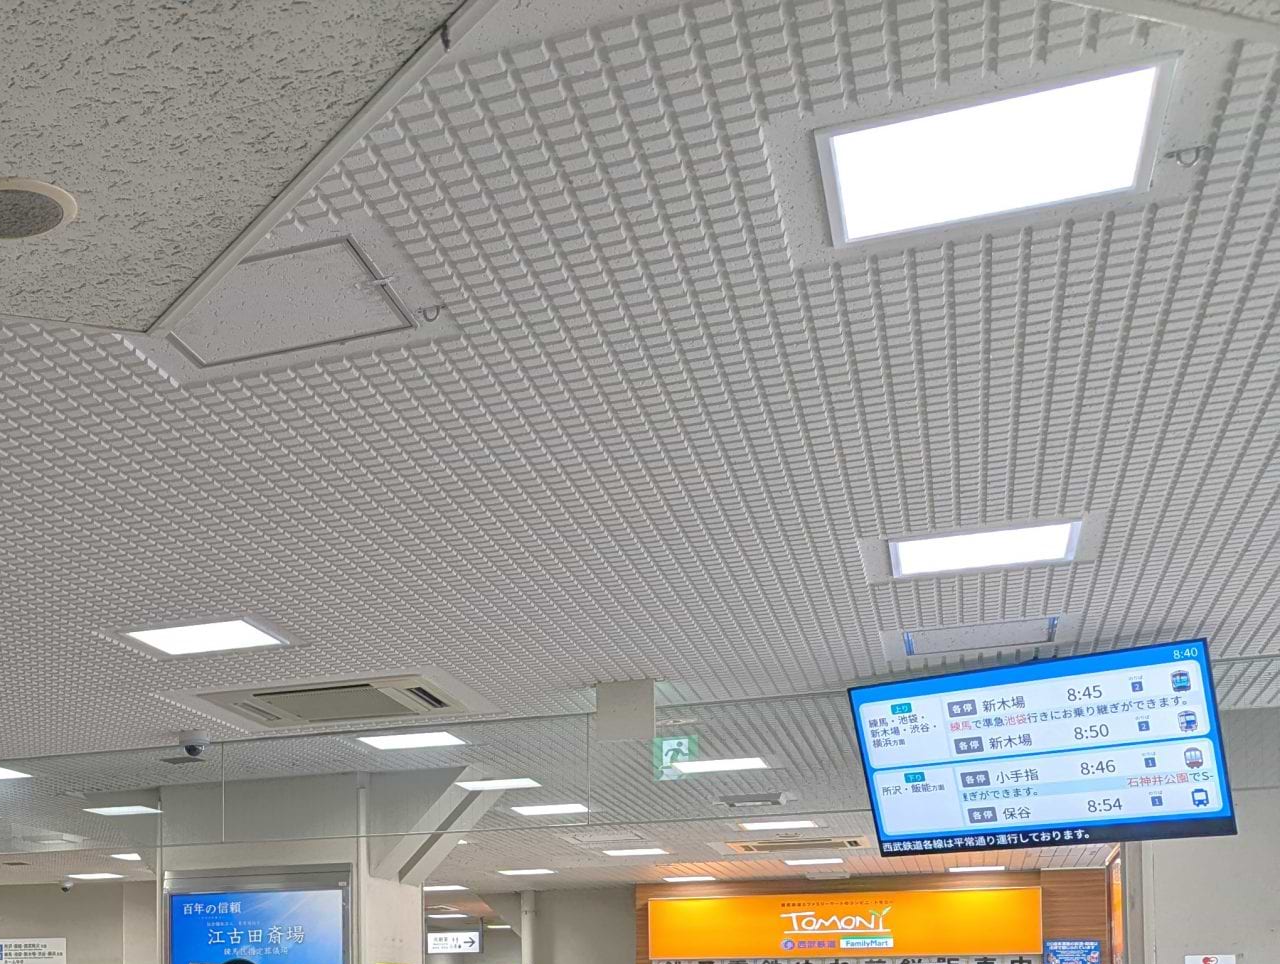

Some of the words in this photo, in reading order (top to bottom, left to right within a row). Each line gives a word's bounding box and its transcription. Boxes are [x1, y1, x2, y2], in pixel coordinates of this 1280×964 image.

[1173, 647, 1198, 660] 8:40
[1067, 685, 1102, 701] 8:45
[894, 704, 908, 714] 上り
[952, 703, 973, 714] 各停
[982, 696, 1025, 712] 新木場
[1074, 724, 1109, 740] 8:50
[872, 738, 905, 748] 横浜方面
[959, 740, 980, 751] 各停
[989, 733, 1032, 750] 新木場
[1080, 760, 1116, 776] 8:46
[907, 773, 921, 783] 下り
[965, 775, 986, 786] 各停
[996, 768, 1039, 784] 小手指
[1088, 798, 1122, 812] 8:54
[972, 811, 993, 821] 各停
[1003, 807, 1031, 820] 保谷
[882, 830, 1090, 851] 西武鉄道各線は平常通り運行しております。
[182, 902, 241, 915] 百年の信頼
[208, 925, 305, 945] 江古田斎場
[846, 940, 888, 948] FamilyMart
